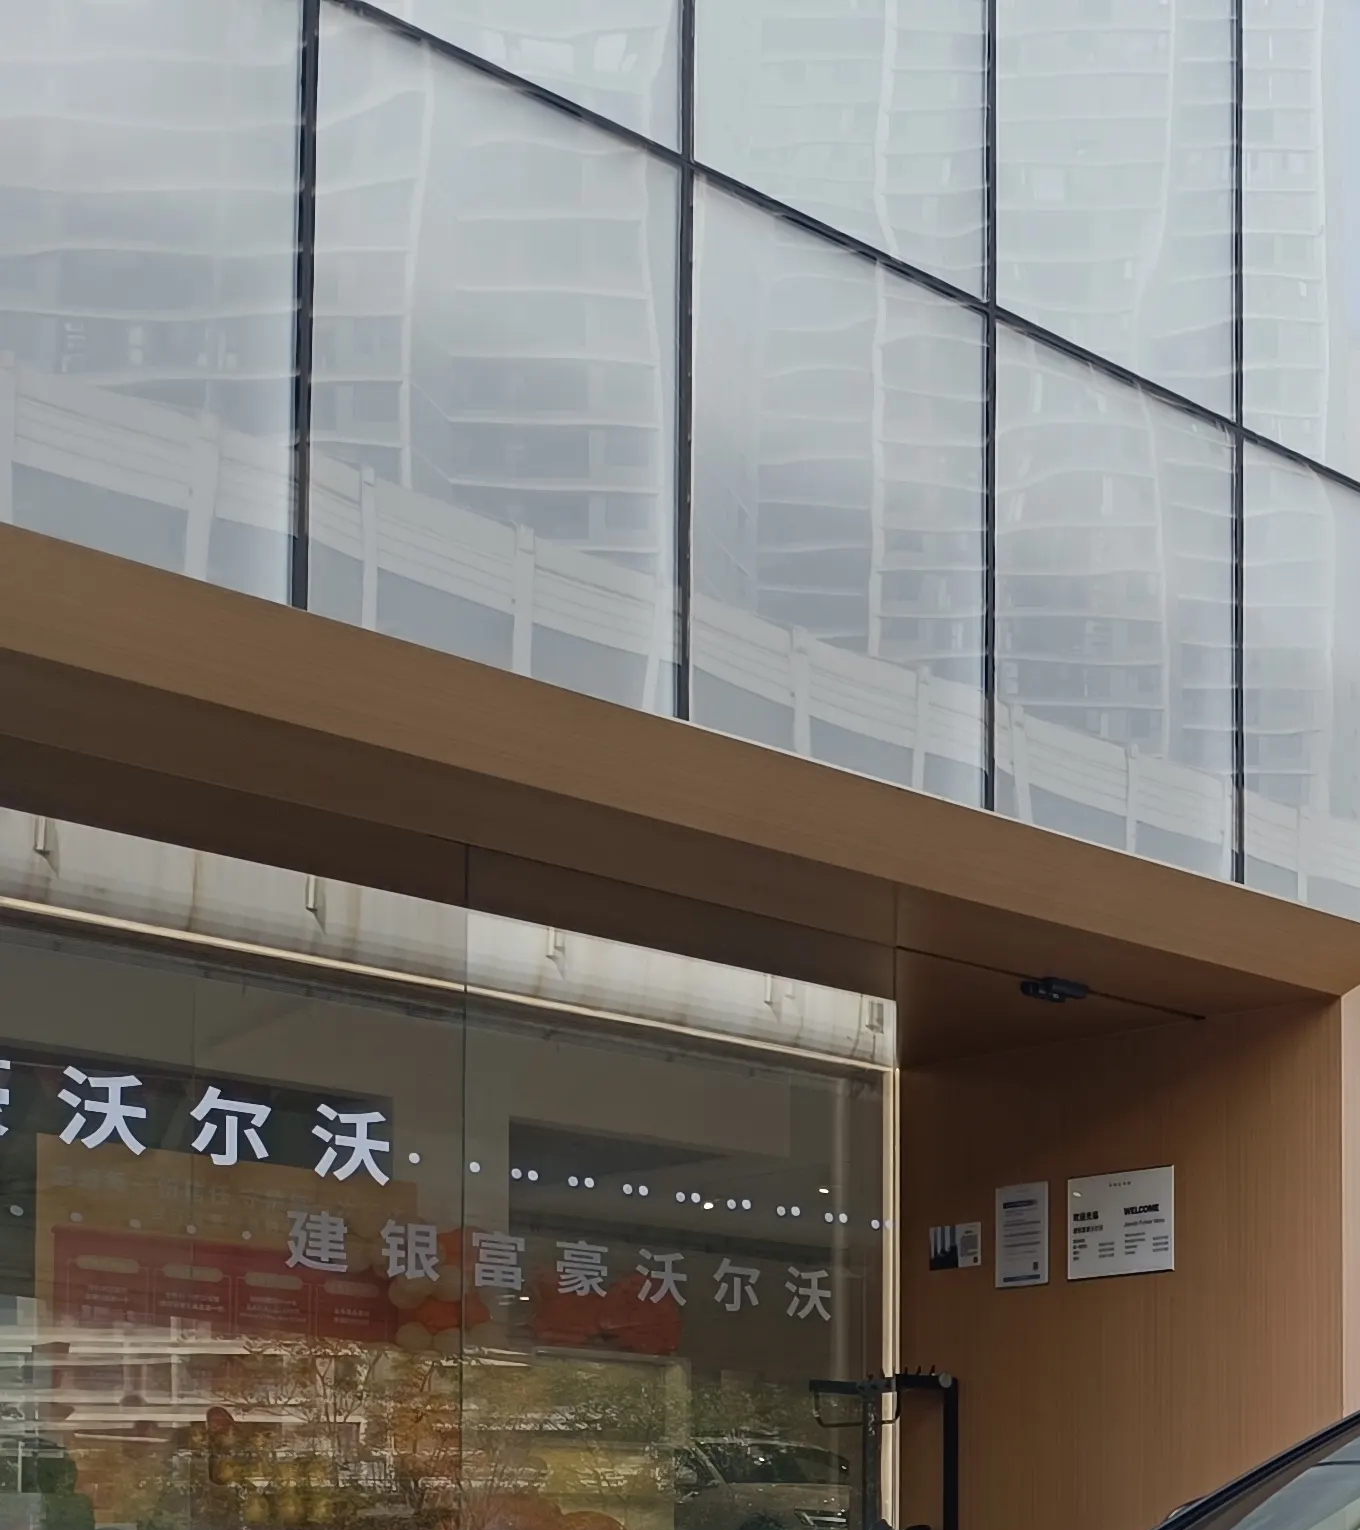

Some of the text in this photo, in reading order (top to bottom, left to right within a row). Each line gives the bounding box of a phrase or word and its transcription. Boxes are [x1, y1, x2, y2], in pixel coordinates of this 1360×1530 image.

[0, 1060, 390, 1187] 沃尔沃
[285, 1209, 833, 1322] 建银富豪沃尔沃
[1123, 1203, 1160, 1216] WELCOME
